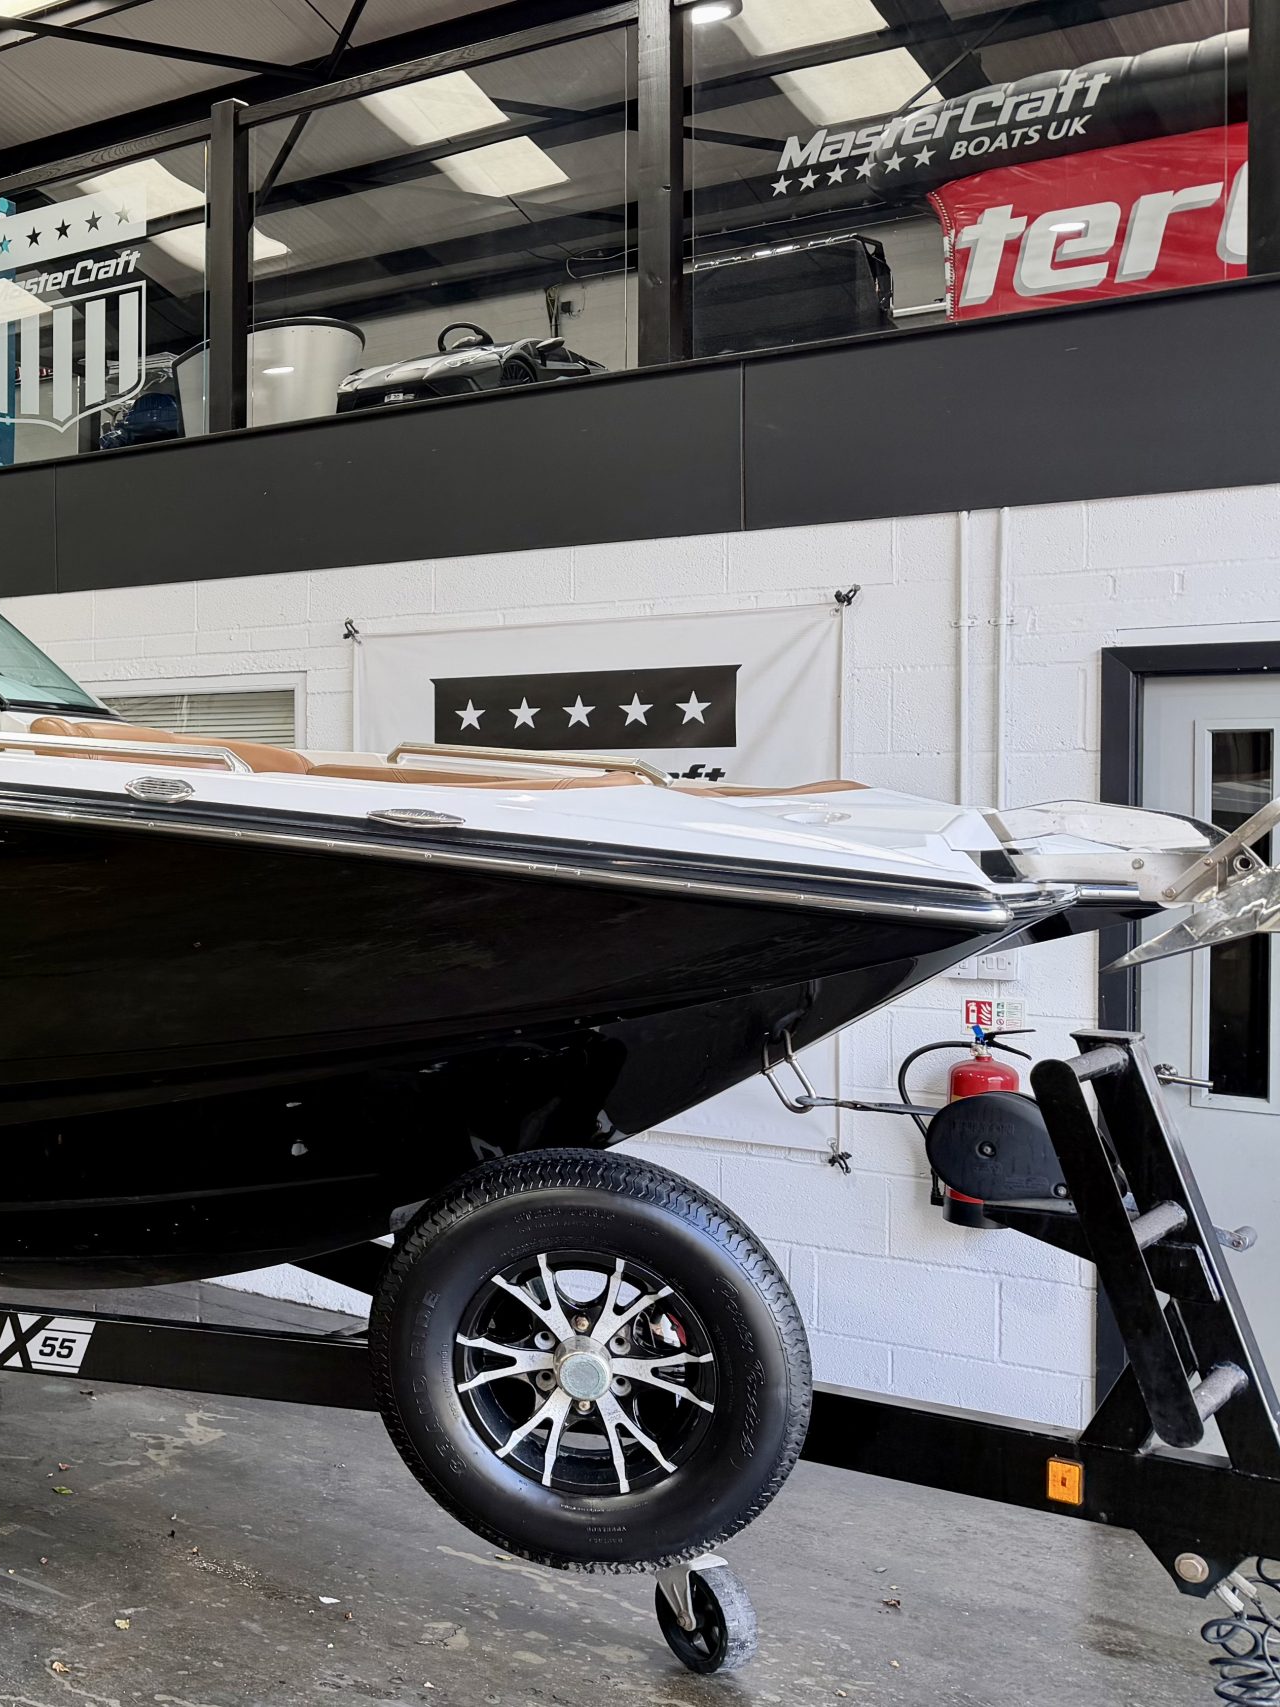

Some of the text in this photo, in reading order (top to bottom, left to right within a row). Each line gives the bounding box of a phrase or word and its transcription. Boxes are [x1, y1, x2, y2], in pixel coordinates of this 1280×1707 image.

[776, 71, 1111, 172] MasterCraft
[949, 114, 1093, 161] BOATS UK
